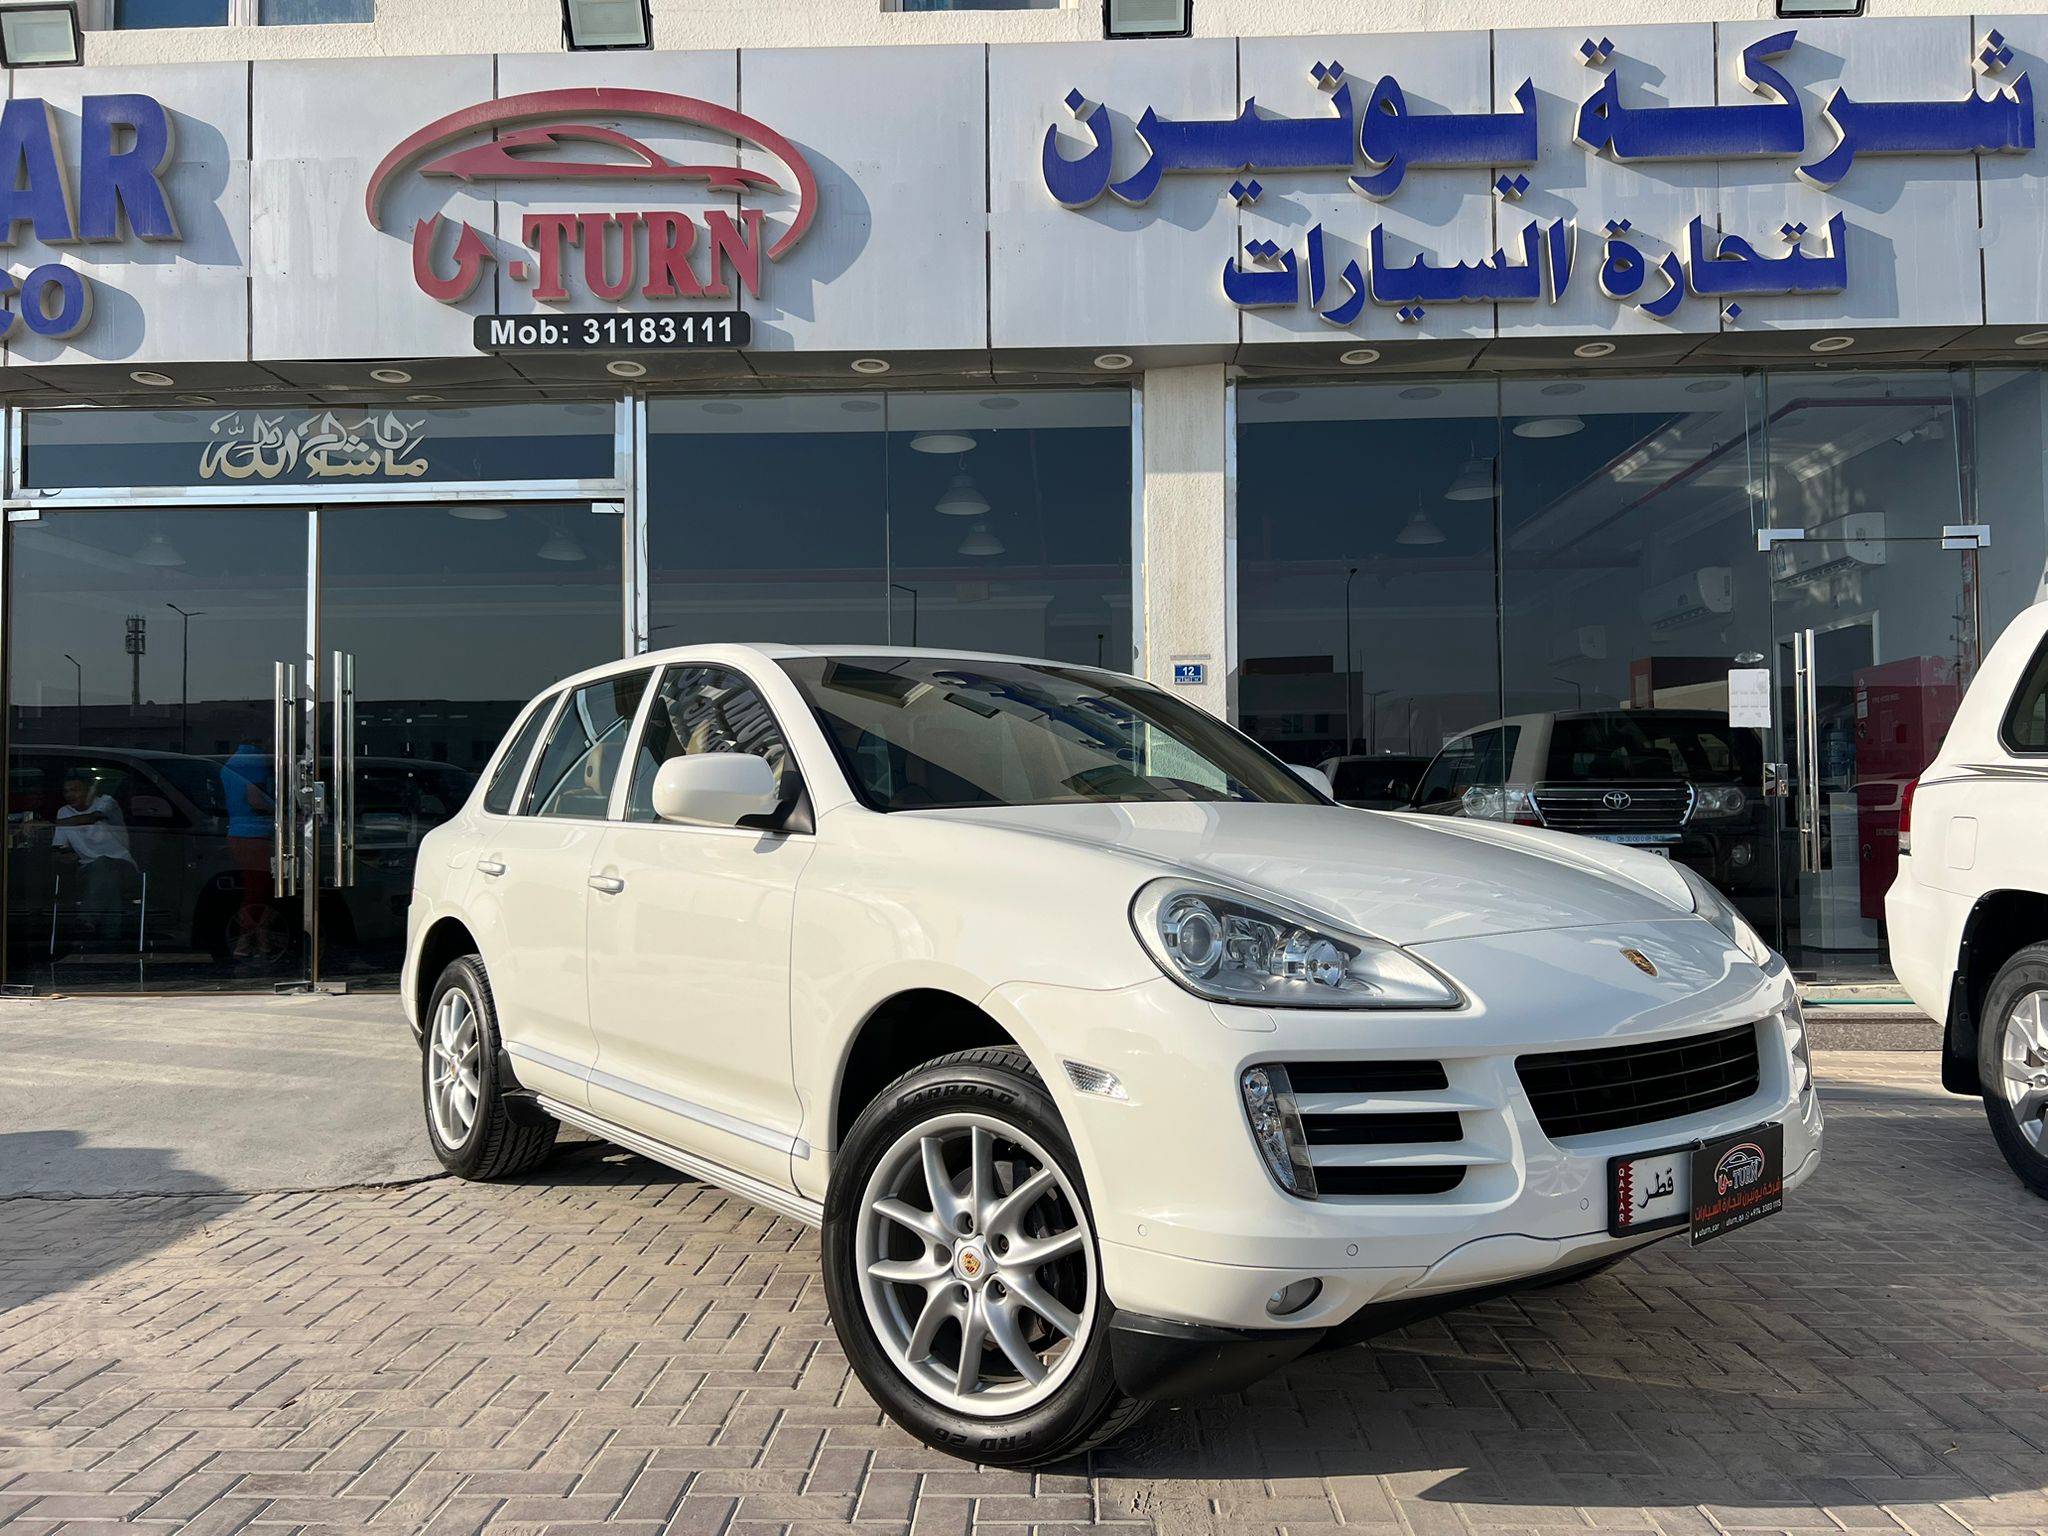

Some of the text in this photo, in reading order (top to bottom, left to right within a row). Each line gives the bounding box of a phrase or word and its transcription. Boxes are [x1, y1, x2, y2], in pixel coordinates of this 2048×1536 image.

[1573, 28, 2034, 190] شركة
[1223, 210, 1848, 328] لتجارة السيارات
[490, 316, 732, 345] Mob: 31183111
[1182, 666, 1195, 676] 12
[1617, 1166, 1627, 1223] QATAR
[1637, 1167, 1674, 1209] قطر
